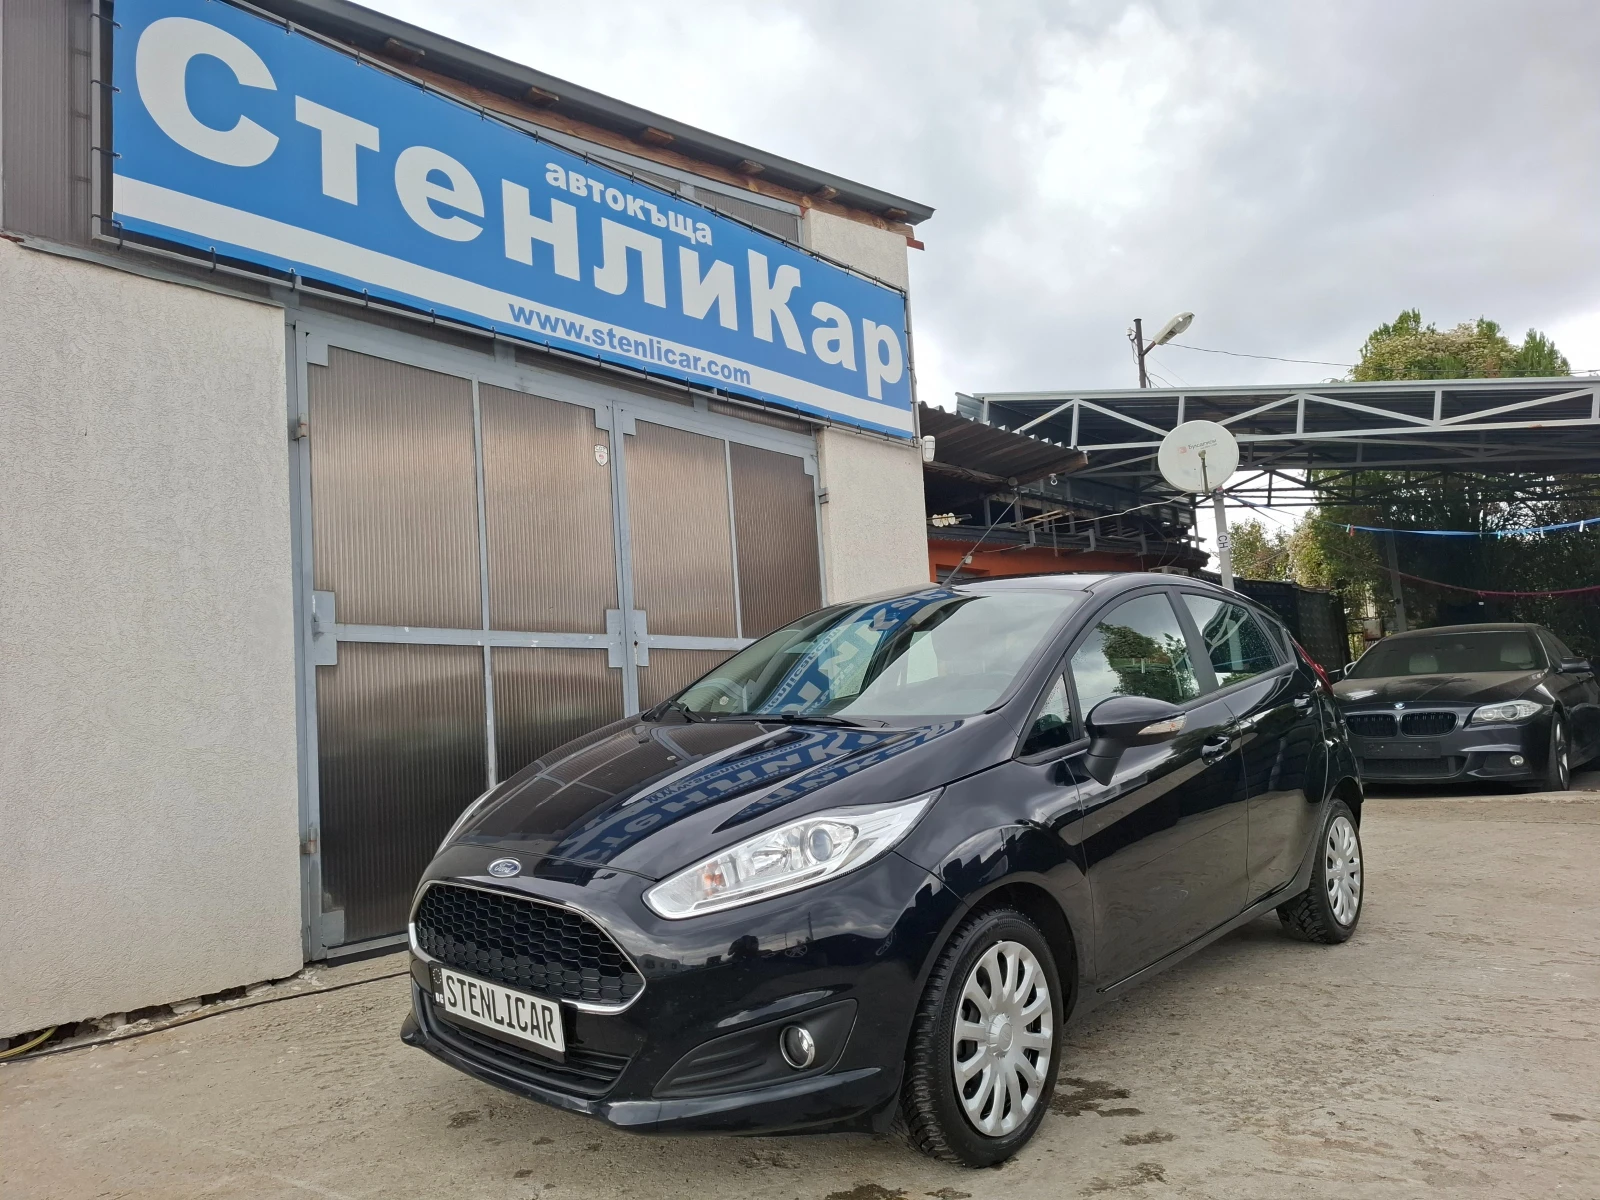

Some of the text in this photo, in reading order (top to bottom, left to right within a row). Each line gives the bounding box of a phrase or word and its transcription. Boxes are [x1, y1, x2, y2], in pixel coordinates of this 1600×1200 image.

[135, 16, 904, 400] СтенлиКар
[545, 162, 713, 246] автокъща
[508, 302, 752, 386] www.stenlicar.com
[446, 974, 557, 1044] STENLICAR
